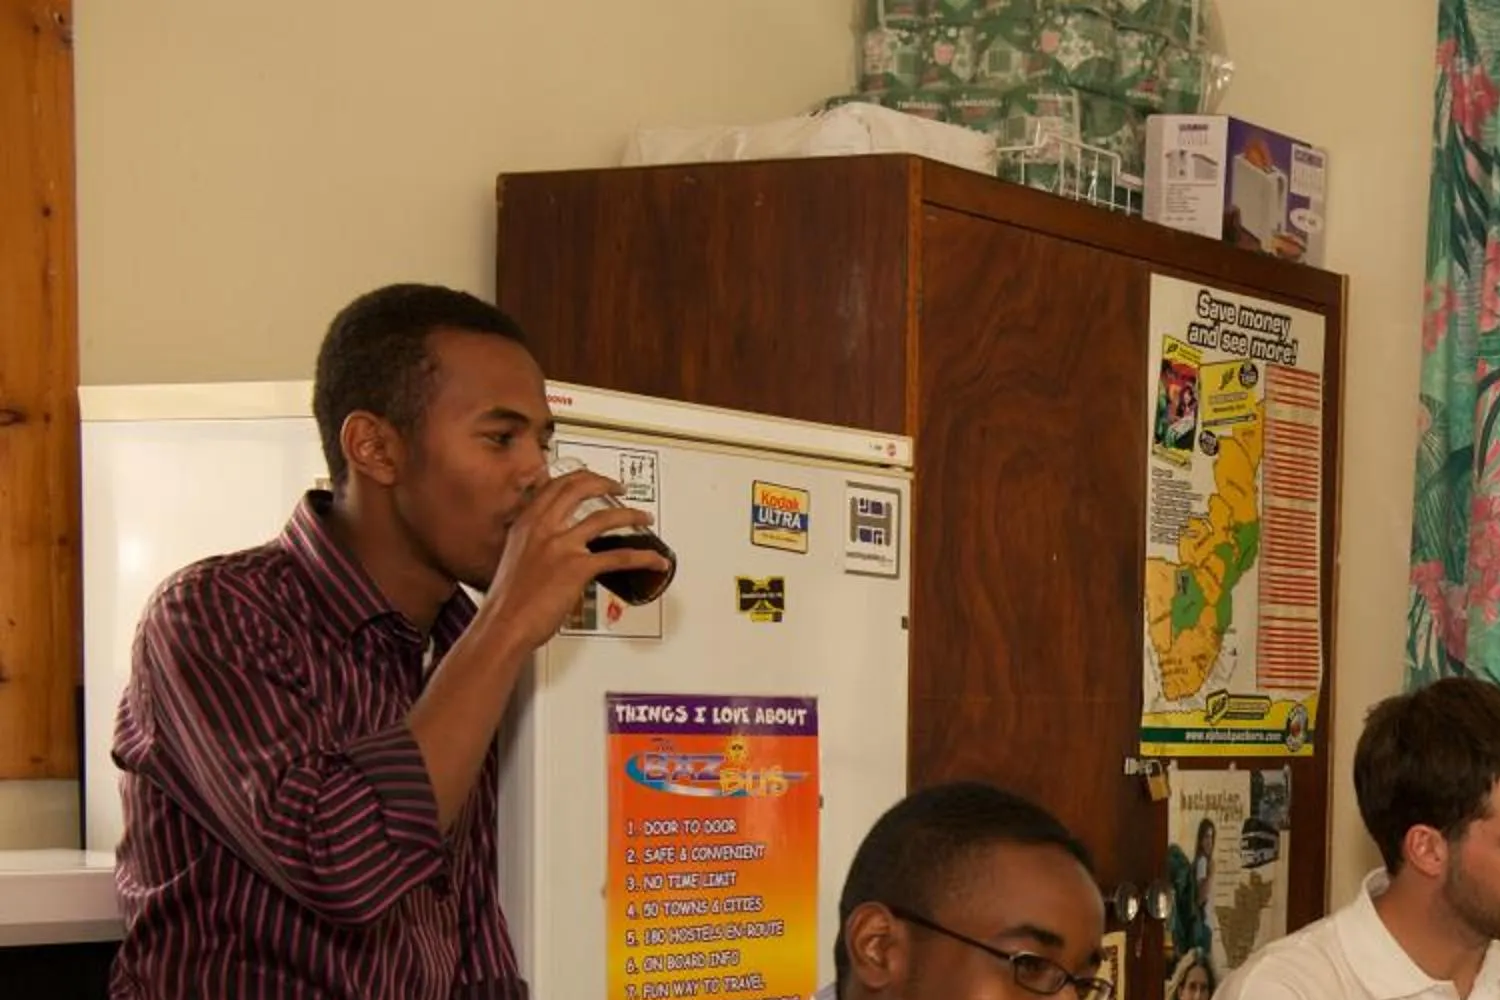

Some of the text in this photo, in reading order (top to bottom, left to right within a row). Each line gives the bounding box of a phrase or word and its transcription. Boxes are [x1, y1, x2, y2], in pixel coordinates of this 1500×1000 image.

[1198, 290, 1292, 341] Save money
[1188, 323, 1219, 348] and
[1220, 331, 1249, 356] see
[1250, 339, 1299, 366] more!
[760, 490, 801, 510] Kodak
[758, 507, 802, 529] ULTRA
[615, 704, 807, 726] THINGS I LOVE ABOUT
[644, 752, 725, 783] BAZ
[720, 766, 789, 798] BUS
[644, 820, 678, 836] DOOR
[684, 820, 700, 834] TO
[703, 819, 737, 834] DOOR
[626, 844, 765, 863] 2. SAFE & CONVENIENT
[627, 871, 737, 891] 3. NO TIME LIMIT
[663, 899, 708, 915] TOWNS
[723, 895, 762, 911] CITIES
[627, 931, 639, 945] 5.
[668, 925, 721, 943] HOSTELS
[643, 956, 663, 971] ON
[667, 954, 705, 970] BOARD
[709, 951, 739, 966] INFO
[643, 983, 669, 998] FUN
[673, 981, 699, 996] WAY
[704, 979, 719, 993] TO
[724, 975, 764, 991] TRAVEL
